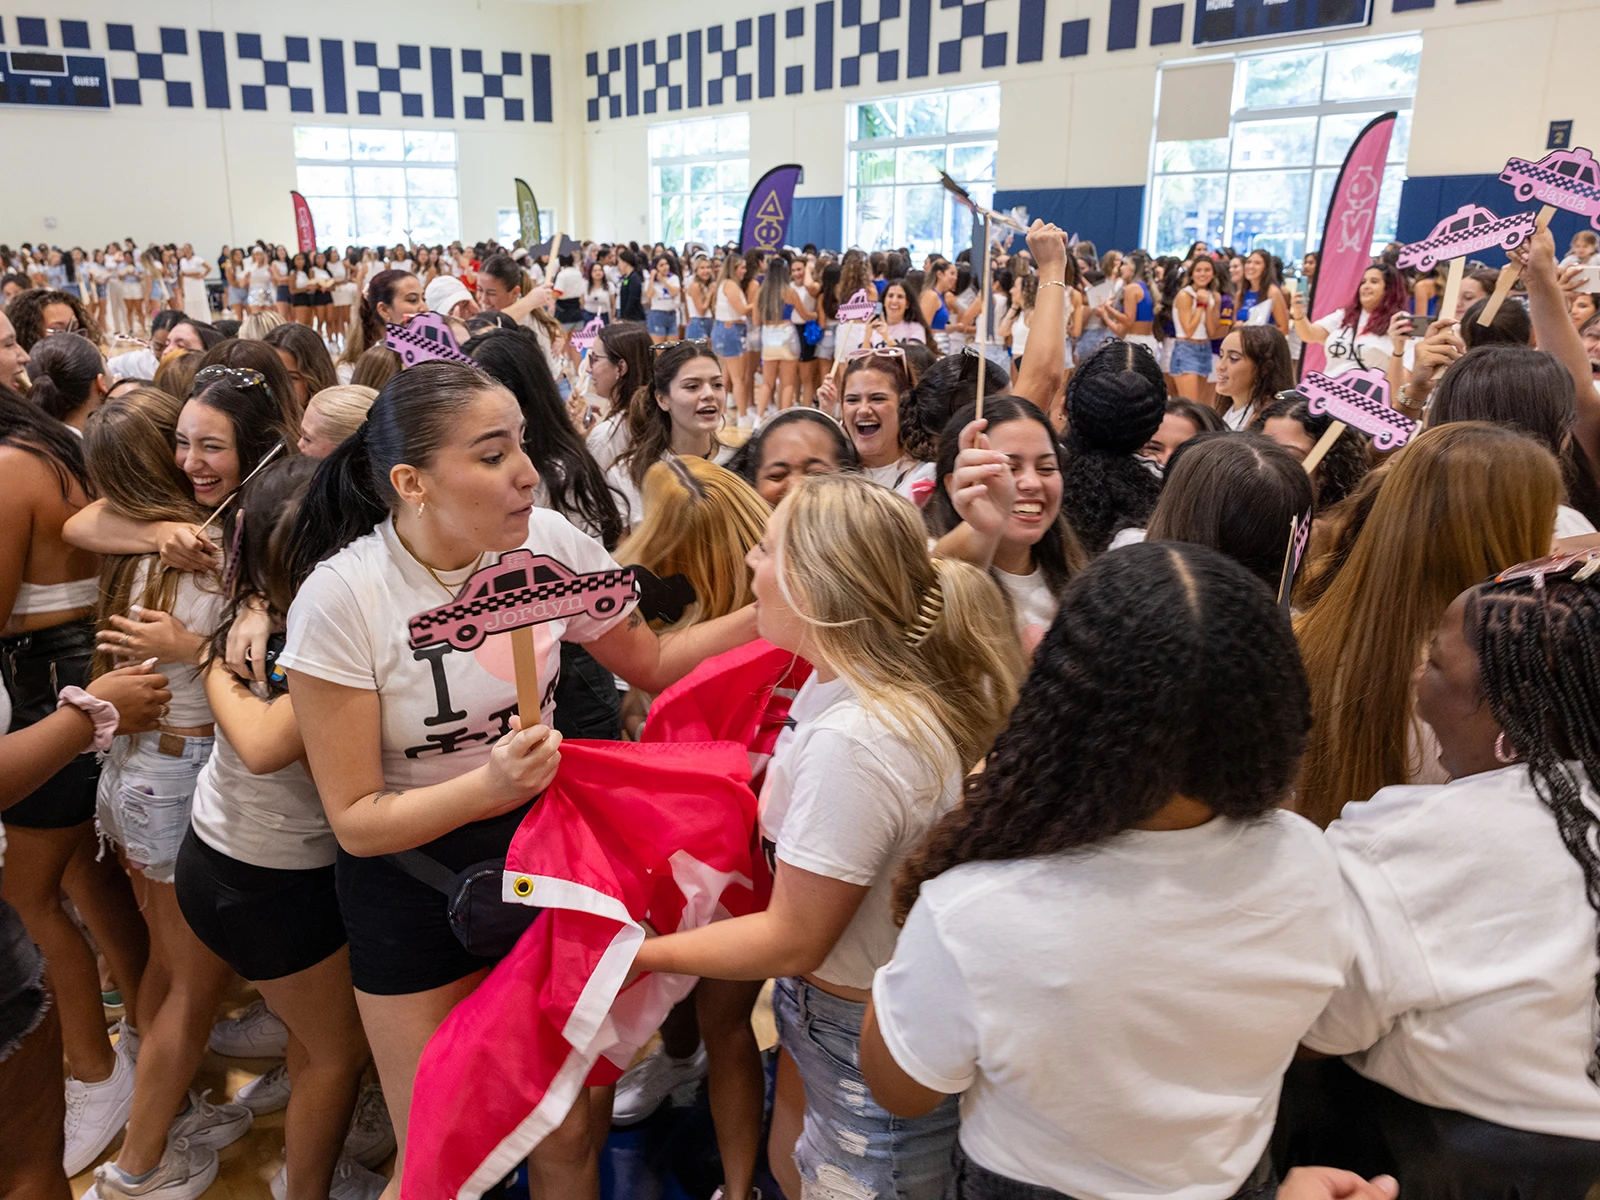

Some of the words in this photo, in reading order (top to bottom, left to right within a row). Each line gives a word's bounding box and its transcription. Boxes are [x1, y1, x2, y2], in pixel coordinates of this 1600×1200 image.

[72, 75, 100, 87] GUEST
[1553, 131, 1565, 145] 2
[1536, 185, 1587, 212] Jayda
[1429, 233, 1508, 262] Charlotte
[484, 595, 585, 630] Jordyn
[413, 644, 468, 727] I
